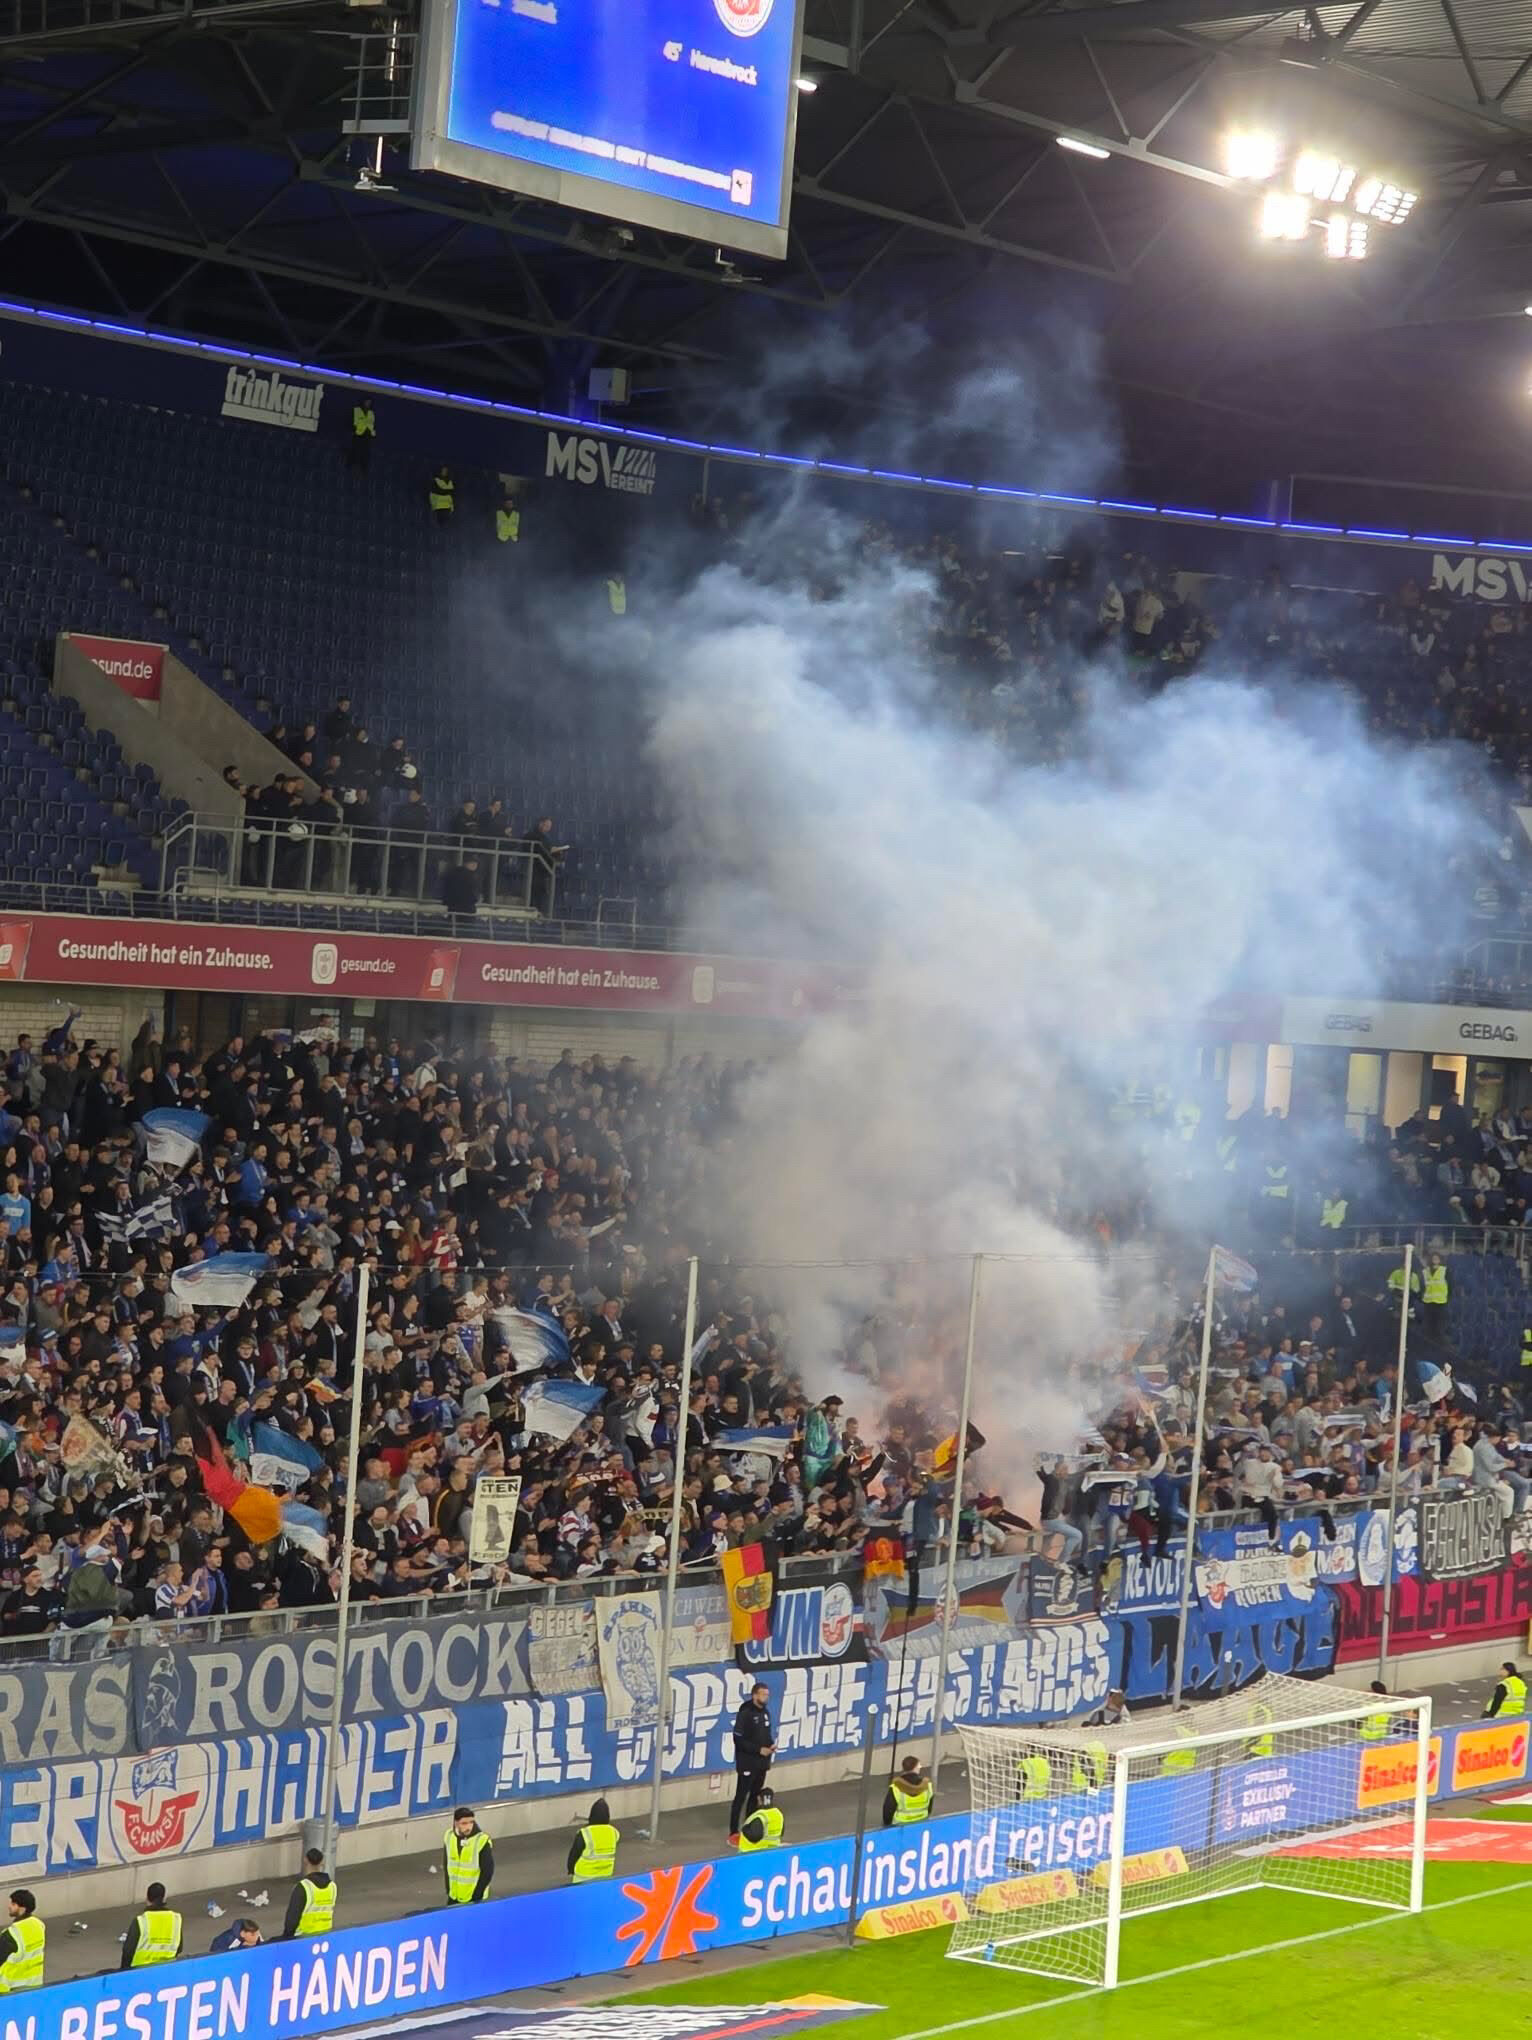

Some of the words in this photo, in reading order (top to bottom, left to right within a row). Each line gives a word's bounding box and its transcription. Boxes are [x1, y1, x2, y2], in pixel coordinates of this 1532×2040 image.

[225, 366, 324, 425] trinkgut
[91, 658, 153, 680] sund.de
[58, 938, 148, 962] Gesundheit
[151, 944, 177, 964] hat
[179, 946, 202, 966] ein
[205, 948, 274, 969] Zuhause.
[341, 958, 396, 974] gesund.de
[481, 963, 556, 984] Gesundheit
[558, 968, 580, 986] hat
[581, 970, 601, 987] ein
[603, 971, 660, 990] Zuhause.
[0, 1663, 131, 1762] RAS
[186, 1621, 531, 1737] ROSTOCK
[494, 1694, 594, 1798] ALL
[772, 1661, 869, 1757] ARE
[1458, 1743, 1509, 1774] Sinalco
[741, 1817, 997, 1928] schauinsland
[1006, 1806, 1115, 1868] reisen
[880, 1908, 937, 1936] Sinalco
[60, 1973, 249, 2040] BESTEN
[269, 1932, 449, 2026] HÄNDEN
